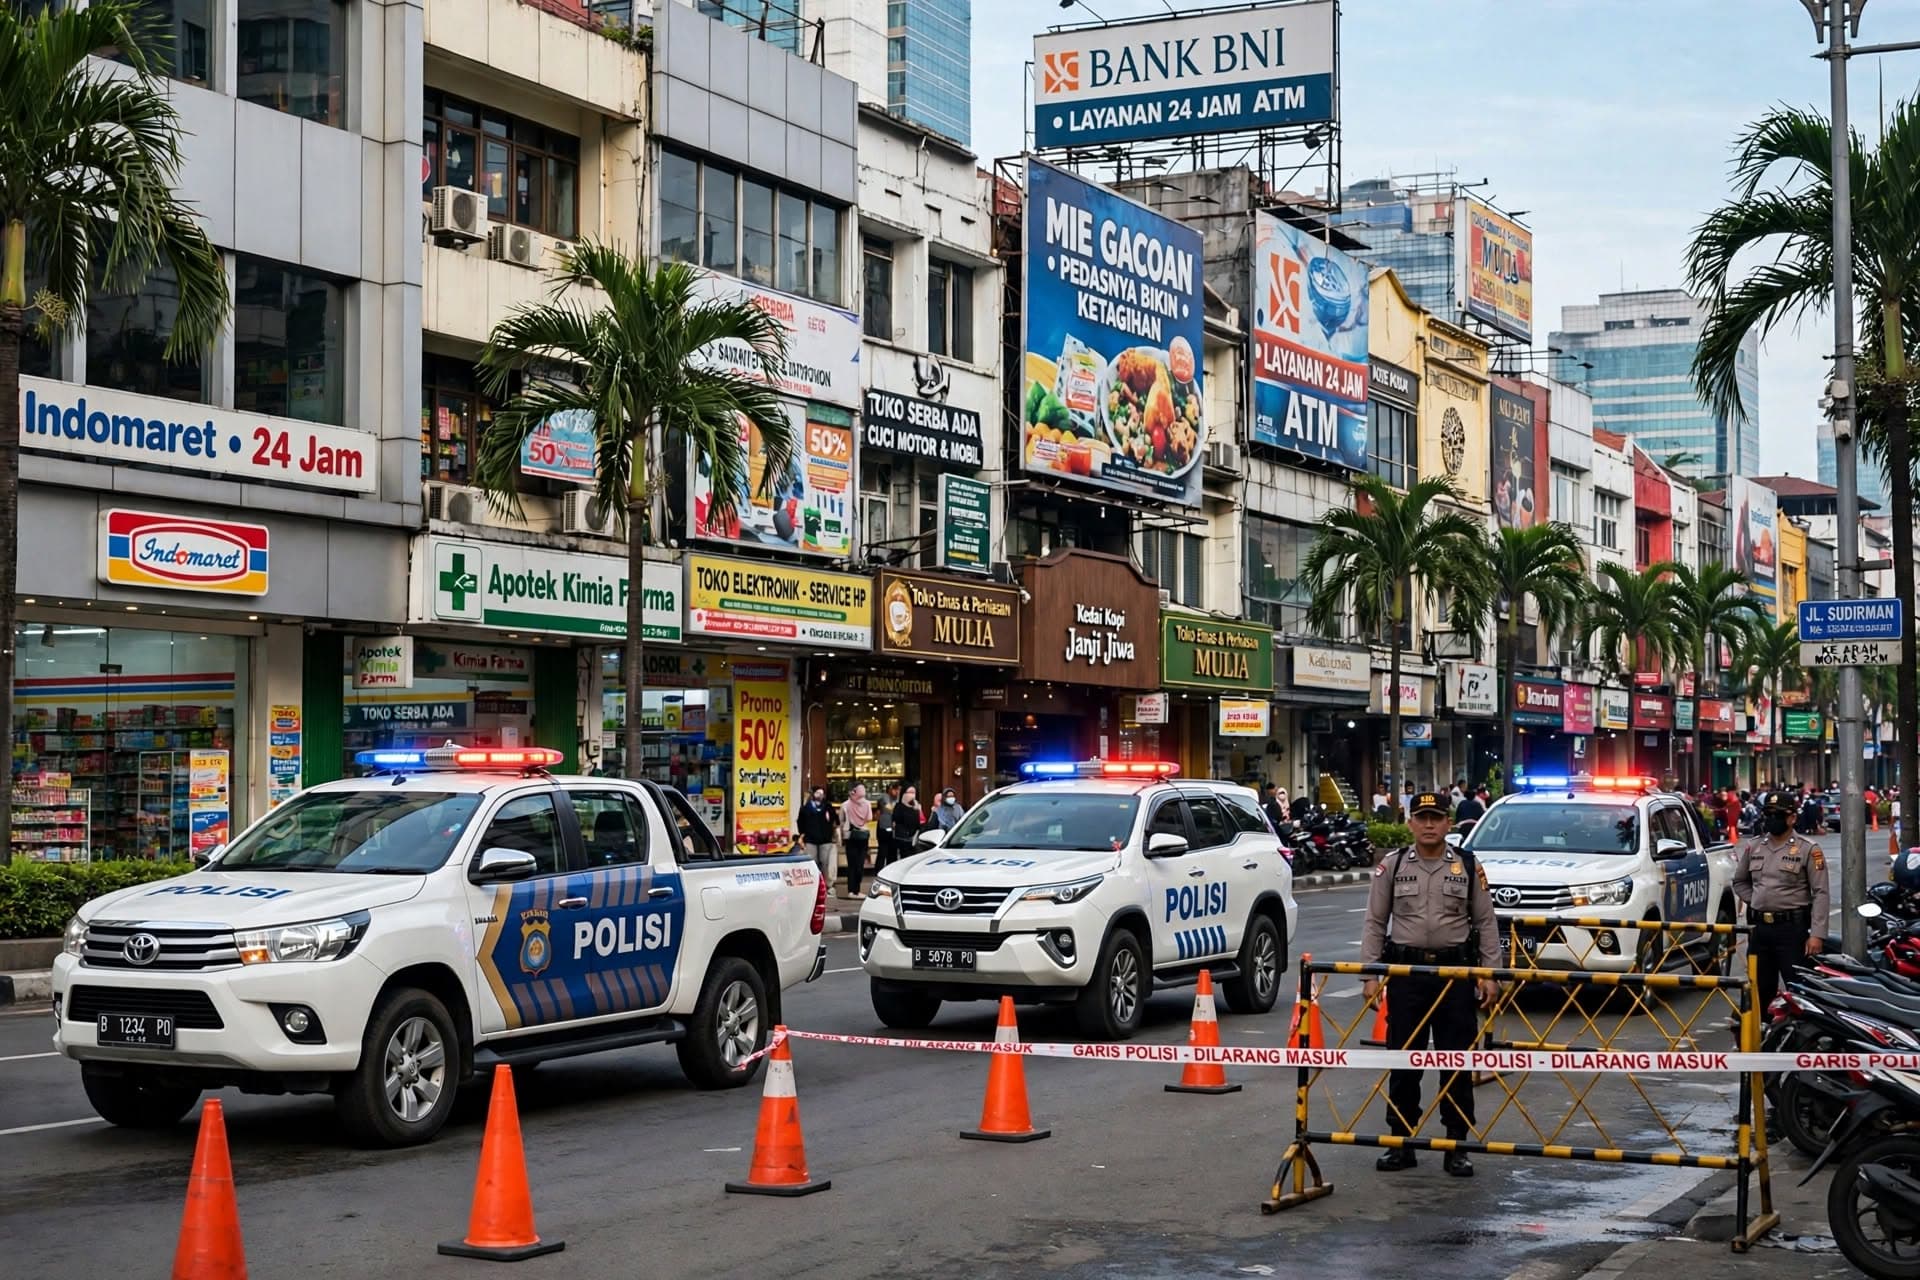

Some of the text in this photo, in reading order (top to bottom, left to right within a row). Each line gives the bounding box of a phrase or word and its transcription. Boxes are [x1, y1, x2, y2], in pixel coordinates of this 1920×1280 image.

[1089, 27, 1285, 88] BANK BNI
[1069, 85, 1305, 132] LAYANAN 24 JAM ATM
[1046, 197, 1192, 295] MIE GACOAN
[1060, 254, 1178, 319] PEDASNYA BIKIN
[1077, 291, 1161, 342] KETAGIHAN
[1263, 347, 1323, 390] LAYANAN
[1325, 367, 1340, 390] 24
[1341, 372, 1363, 400] JAM
[25, 390, 363, 478] Indomaret 24 Jam
[907, 401, 949, 432] SERBA
[952, 412, 978, 438] ADA
[1283, 390, 1338, 449] ATM
[810, 428, 848, 457] 50%
[867, 424, 981, 465] CUCI MOTOR & MOBIL
[139, 537, 241, 569] Indomaret
[488, 564, 675, 612] Apotek Kimia Frma
[697, 566, 730, 592] TOKO
[733, 572, 800, 601] ELEKTRONIK
[809, 581, 851, 607] SERVICE
[853, 586, 866, 608] HP
[912, 586, 936, 607] Toko
[937, 591, 960, 610] Emas
[962, 595, 970, 611] &
[1076, 603, 1125, 631] Kedai Kopi
[1806, 604, 1894, 622] JL. SUDIRMAN
[933, 614, 995, 648] MULIA
[1065, 626, 1135, 664] Janji Jiwa
[454, 652, 525, 669] Kimia Farma
[1195, 647, 1249, 679] MULIA
[1815, 654, 1858, 665] MONAS
[1822, 643, 1878, 656] KE ARAH
[362, 705, 455, 720] TOKO SERBA ADA
[740, 690, 783, 713] Promo
[739, 718, 785, 761] 50%
[924, 857, 1037, 868] POLISI
[148, 885, 293, 899] POLISI
[1165, 881, 1228, 923] POLISI
[1684, 879, 1708, 908] POLISI
[573, 912, 672, 960] POLISI
[915, 949, 921, 961] B
[928, 950, 953, 963] 5078
[101, 1015, 108, 1033] B
[119, 1017, 145, 1035] 1234
[903, 1039, 976, 1052] DILARANG
[980, 1042, 1033, 1054] MASUK
[1073, 1044, 1121, 1059] GARIS
[1125, 1046, 1178, 1061] POLISI
[1194, 1049, 1281, 1064] DILARANG
[1286, 1050, 1348, 1066] MASUK
[1409, 1051, 1466, 1067] GARIS
[1472, 1052, 1533, 1068] POLISI
[1551, 1053, 1651, 1069] DILARANG
[1657, 1053, 1729, 1069] MASUK
[1796, 1053, 1861, 1068] GARIS
